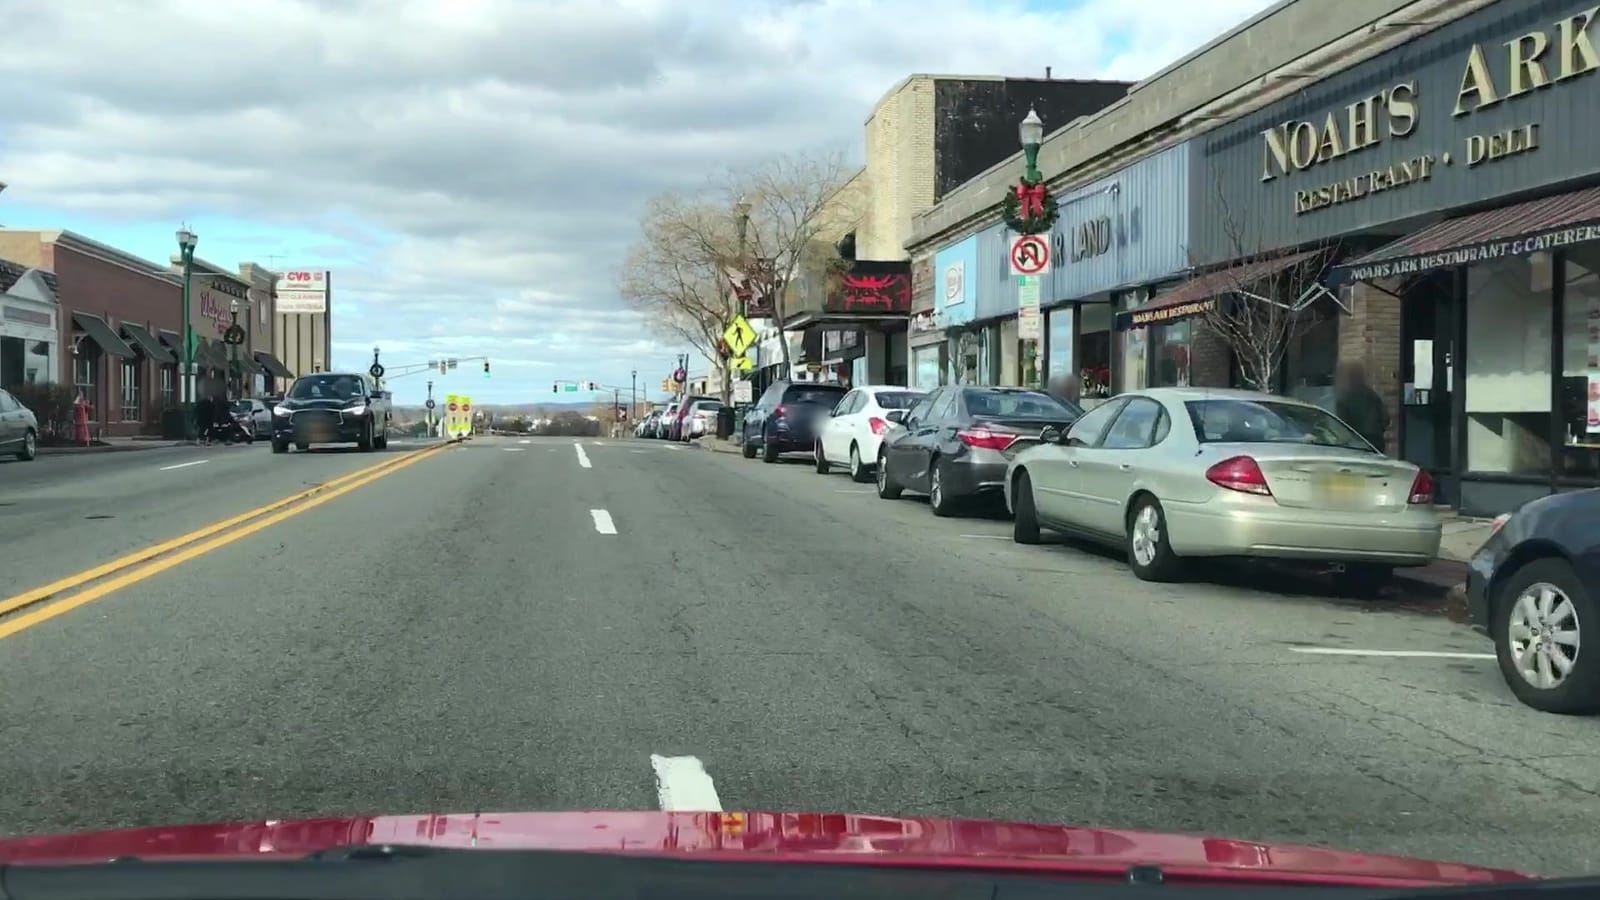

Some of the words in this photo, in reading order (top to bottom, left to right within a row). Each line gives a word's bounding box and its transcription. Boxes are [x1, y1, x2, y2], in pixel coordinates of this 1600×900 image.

[1260, 80, 1419, 181] NOAH'S
[1452, 6, 1600, 116] ARK
[1295, 154, 1435, 214] RESTAURANT
[1465, 124, 1540, 167] DELI
[1071, 217, 1111, 264] LAND
[1391, 258, 1418, 275] ARK
[1420, 242, 1510, 271] RESTAURANT
[287, 271, 311, 281] CVS
